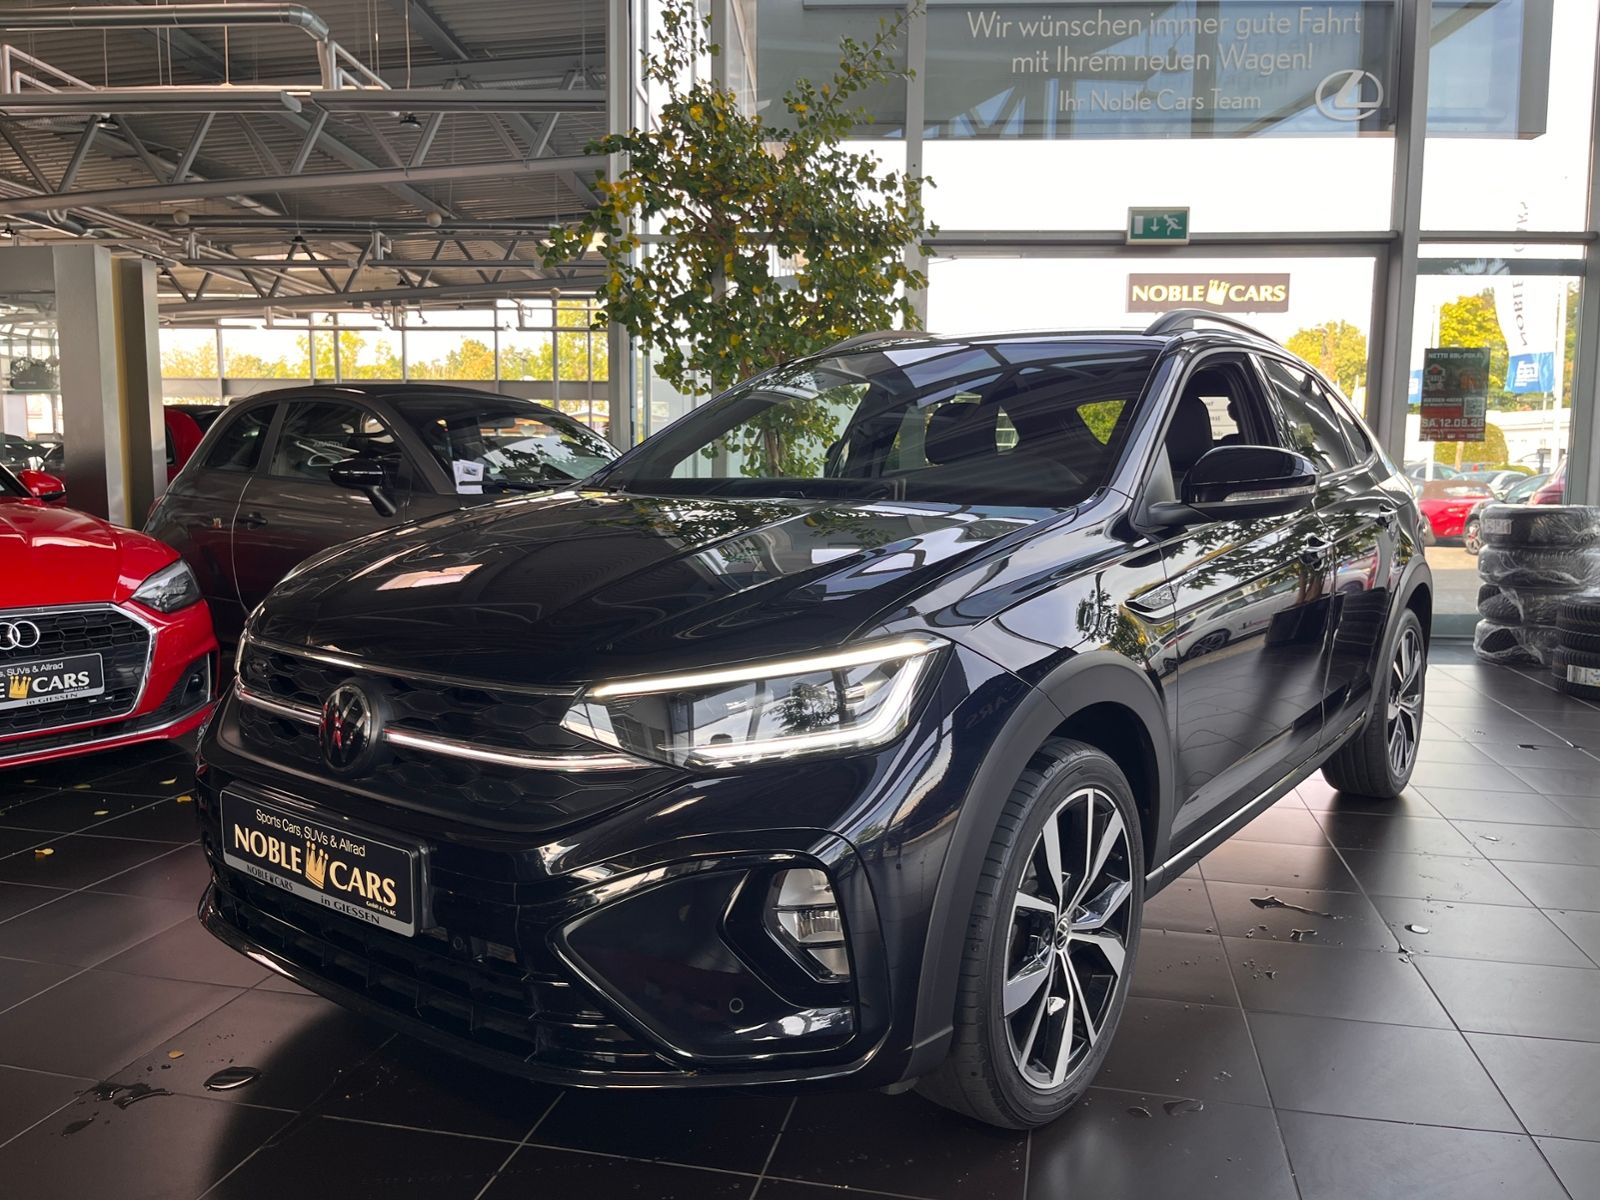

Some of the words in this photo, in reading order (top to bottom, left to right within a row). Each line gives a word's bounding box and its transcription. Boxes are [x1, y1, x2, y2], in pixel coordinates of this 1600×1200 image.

[967, 10, 1012, 38] Wir
[1018, 8, 1142, 38] wünschen
[1150, 12, 1229, 36] immer
[1236, 12, 1291, 40] gute
[1299, 6, 1361, 34] Fahrt
[1012, 50, 1049, 73] mit
[1056, 45, 1126, 73] Ihrem
[1134, 54, 1210, 72] neuen
[1218, 42, 1313, 76] Wagen!
[1059, 90, 1083, 112] Ihr
[1090, 89, 1151, 112] Noble
[1157, 88, 1204, 111] Cars
[1210, 88, 1261, 110] Team
[1132, 285, 1205, 302] NOBLE
[1228, 285, 1287, 302] CARS
[6, 667, 31, 676] SUVs
[32, 665, 39, 673] &
[40, 662, 64, 671] Allrad
[32, 671, 90, 693] CARS
[40, 693, 78, 703] GIESSEN
[256, 809, 281, 829] Sports
[282, 818, 302, 838] Cars,
[304, 826, 328, 845] SUVs
[330, 835, 338, 849] &
[339, 838, 366, 857] Allrad
[234, 823, 302, 874] NOBLE
[329, 861, 397, 907] CARS
[246, 864, 268, 881] NOBLE
[274, 876, 294, 891] CARS
[321, 895, 330, 906] in
[333, 901, 380, 924] GIESSEN
